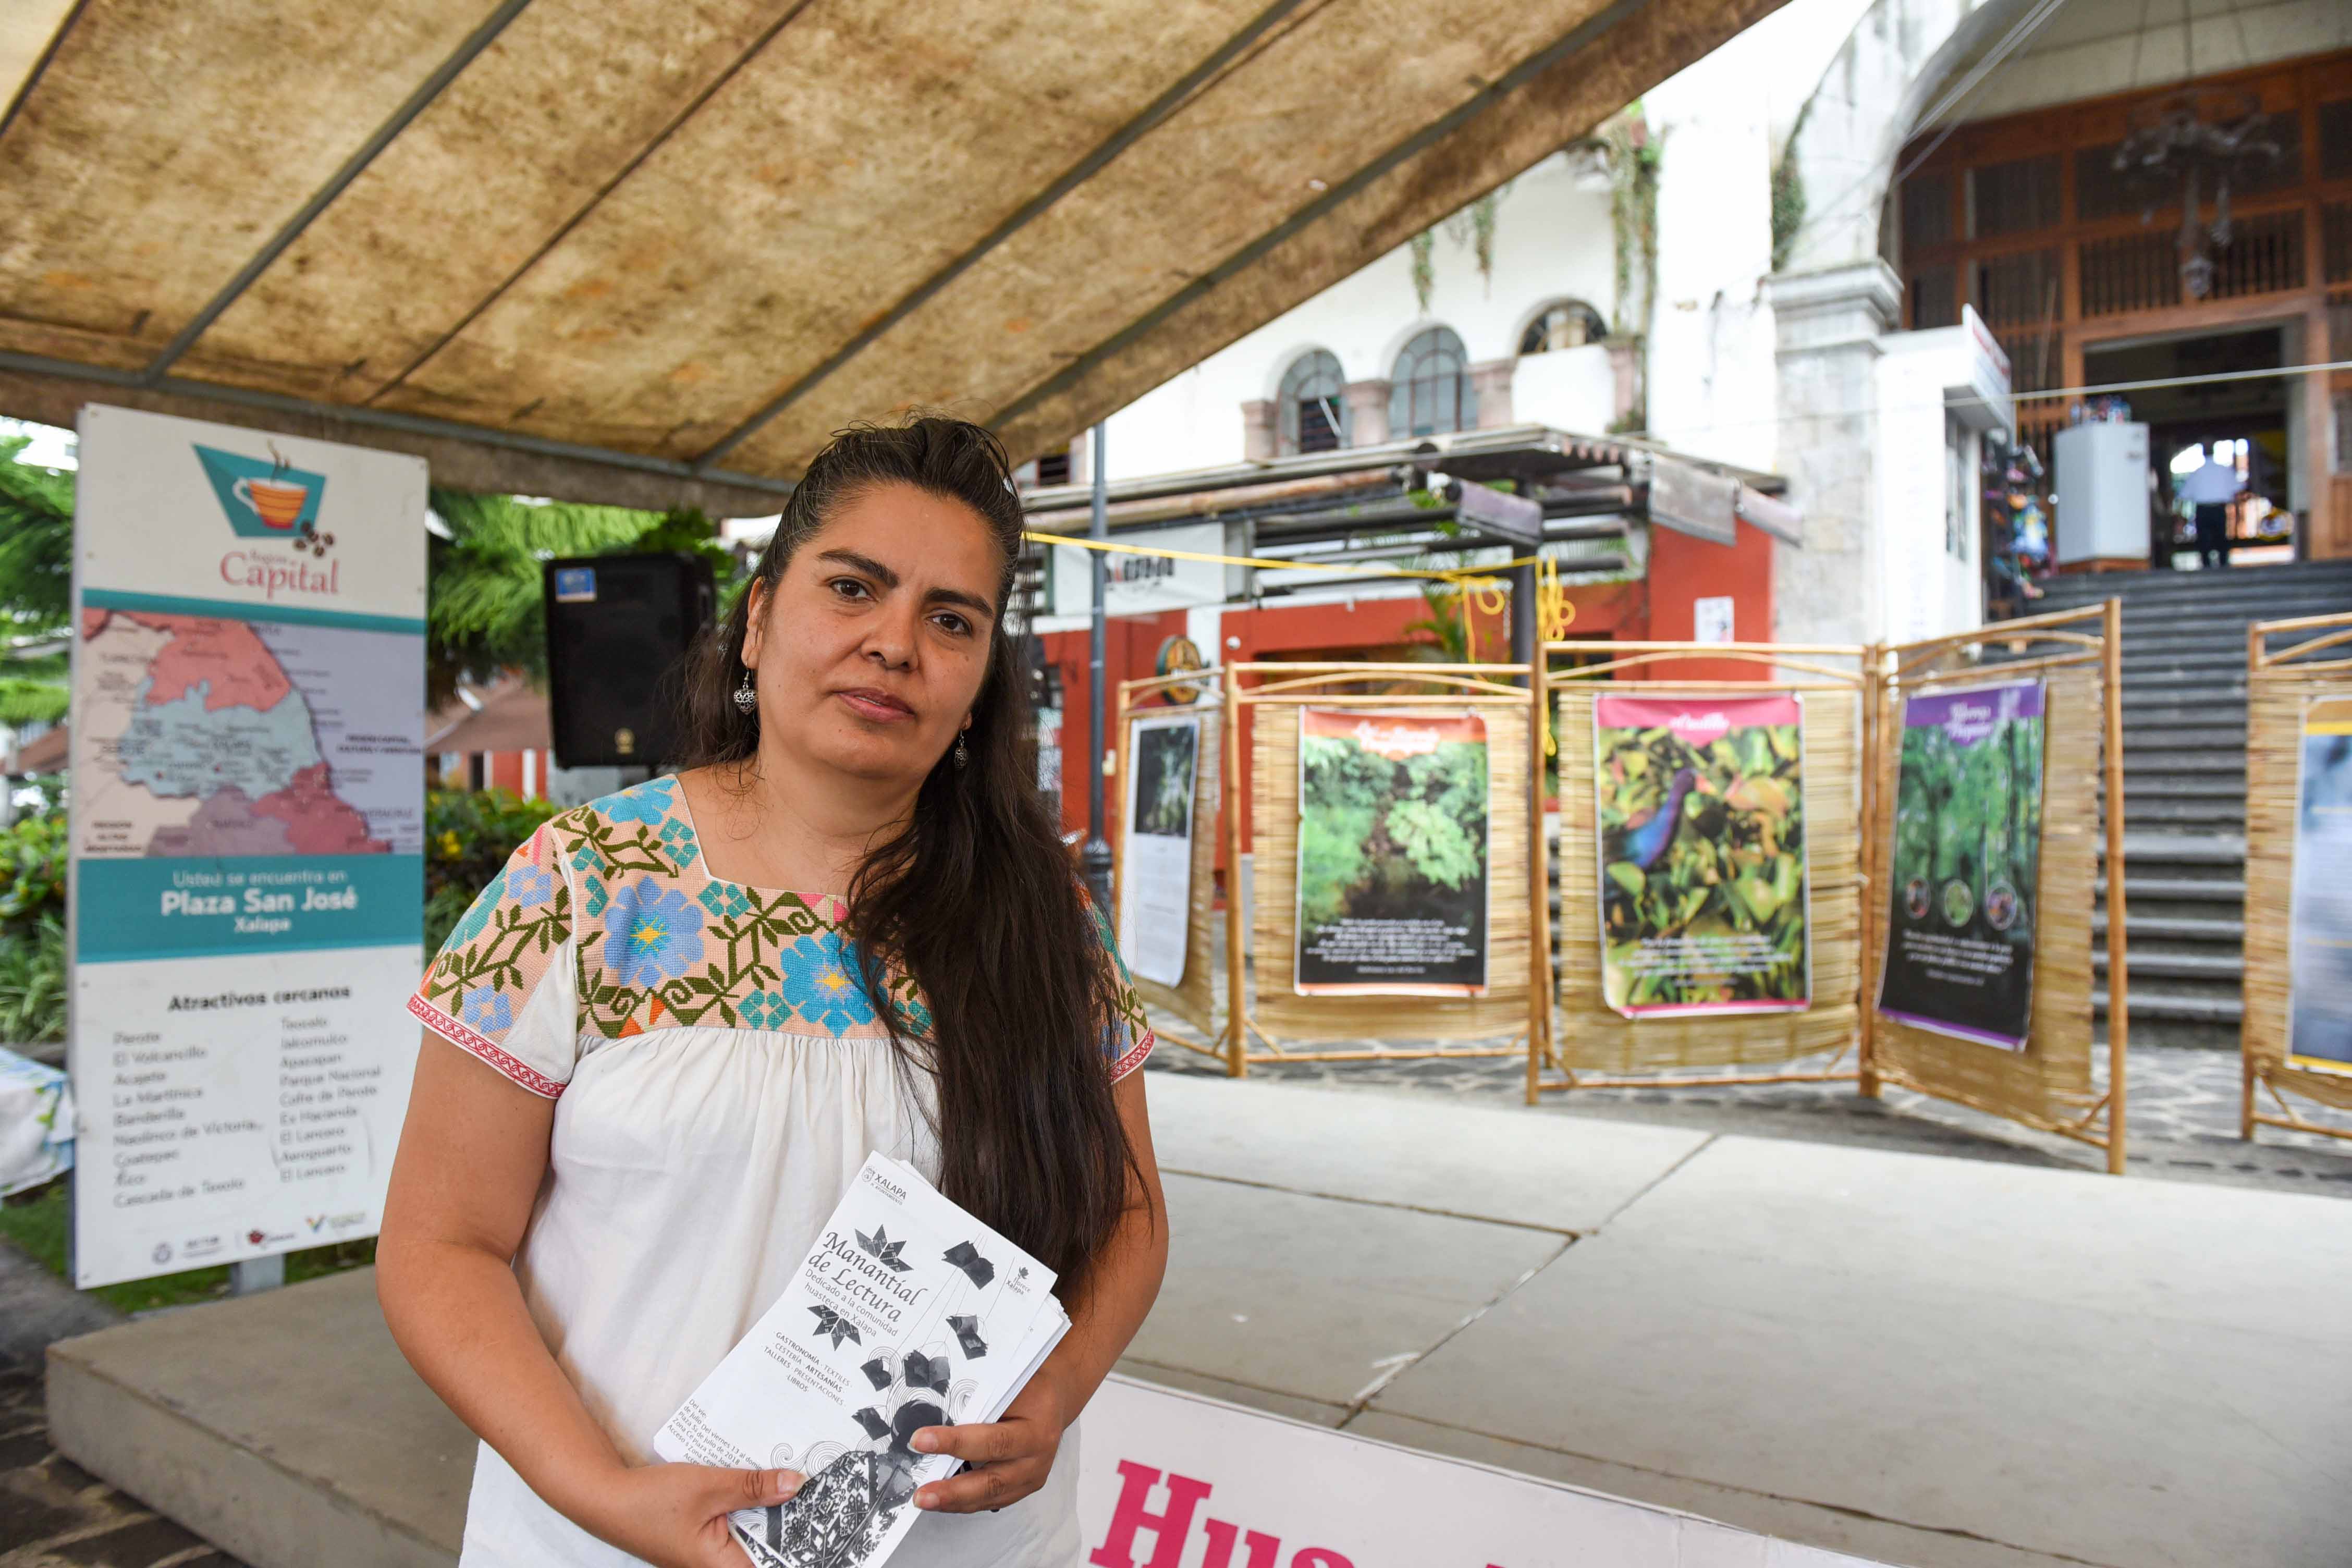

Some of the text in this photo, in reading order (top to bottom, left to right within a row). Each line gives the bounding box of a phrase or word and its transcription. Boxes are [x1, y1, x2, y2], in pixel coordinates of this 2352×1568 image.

[219, 550, 340, 599] Capital
[173, 869, 346, 887] Usted se encuentra en
[161, 885, 359, 916] Plaza San José
[235, 915, 292, 935] Xalapa
[167, 986, 351, 1012] Atractivos cercanos
[280, 1064, 381, 1087] Parque Nacional
[317, 1091, 333, 1103] de
[300, 1106, 359, 1122] Hacienda
[182, 1124, 198, 1139] de
[281, 1144, 351, 1163] Aeropuerto
[179, 1186, 195, 1197] de
[875, 1173, 906, 1199] XALAPA
[875, 1185, 903, 1205] AYUNTAMIENTO
[808, 1251, 902, 1322] de Lectura
[1006, 1280, 1024, 1295] Xalapa
[804, 1282, 877, 1338] huasteca en Xalapa
[805, 1268, 840, 1297] Dedicado
[848, 1296, 855, 1308] la
[856, 1306, 899, 1337] comunidad
[775, 1342, 842, 1392] CESTERÍA ARTESANÍAS
[776, 1331, 851, 1387] GASTRONOMÍA TEXTILES
[764, 1346, 844, 1406] TALLERES PRESENTACIONES
[689, 1399, 699, 1410] Del
[672, 1418, 686, 1432] Zona
[679, 1411, 692, 1426] Plaza
[689, 1412, 702, 1425] julio
[667, 1424, 685, 1442] Acceso
[701, 1424, 712, 1434] Del
[711, 1431, 730, 1448] viernes
[731, 1446, 739, 1454] 13
[688, 1446, 702, 1459] Zona
[692, 1438, 707, 1452] Plaza
[708, 1449, 718, 1460] San
[703, 1436, 716, 1449] julio
[725, 1451, 740, 1465] 2018
